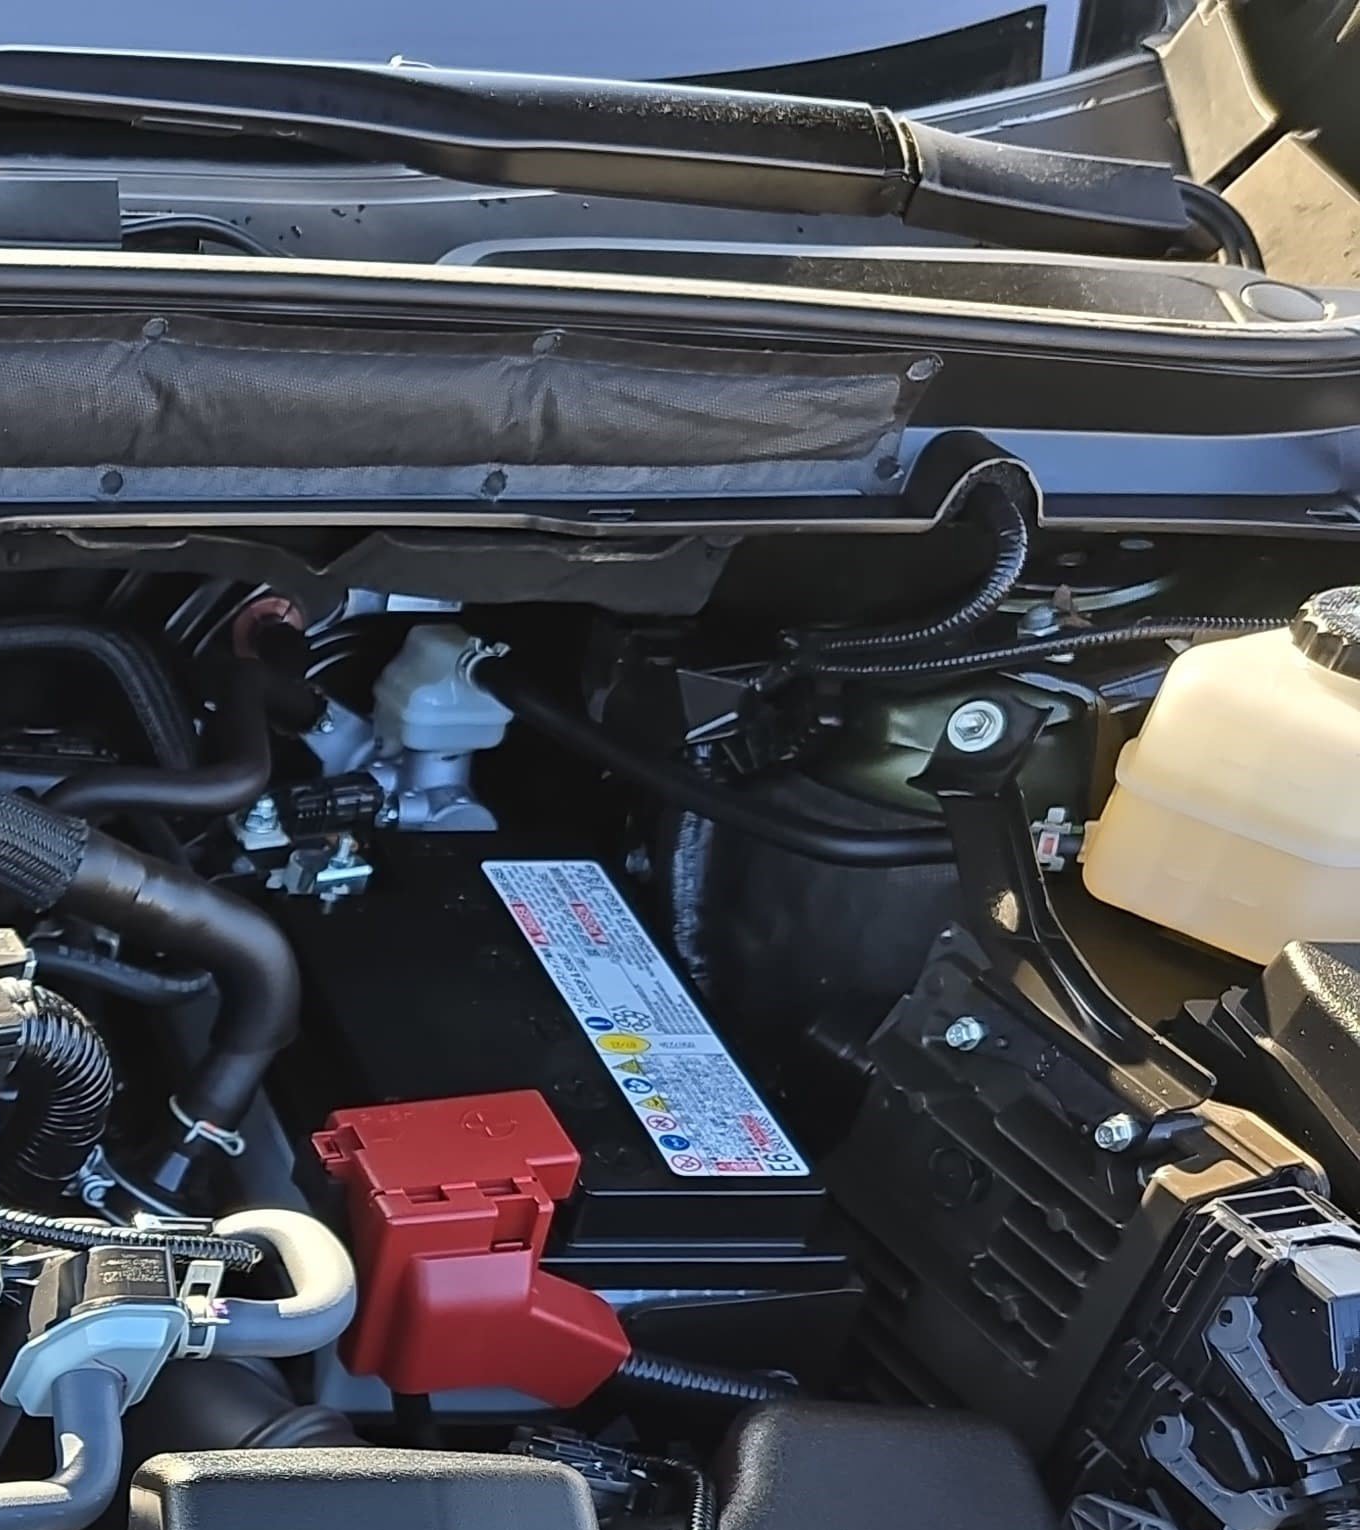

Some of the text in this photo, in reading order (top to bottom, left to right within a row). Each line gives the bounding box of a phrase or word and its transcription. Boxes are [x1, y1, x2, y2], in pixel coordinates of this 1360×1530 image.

[558, 952, 578, 971] START
[573, 978, 592, 994] STOP
[764, 1153, 801, 1173] E6
